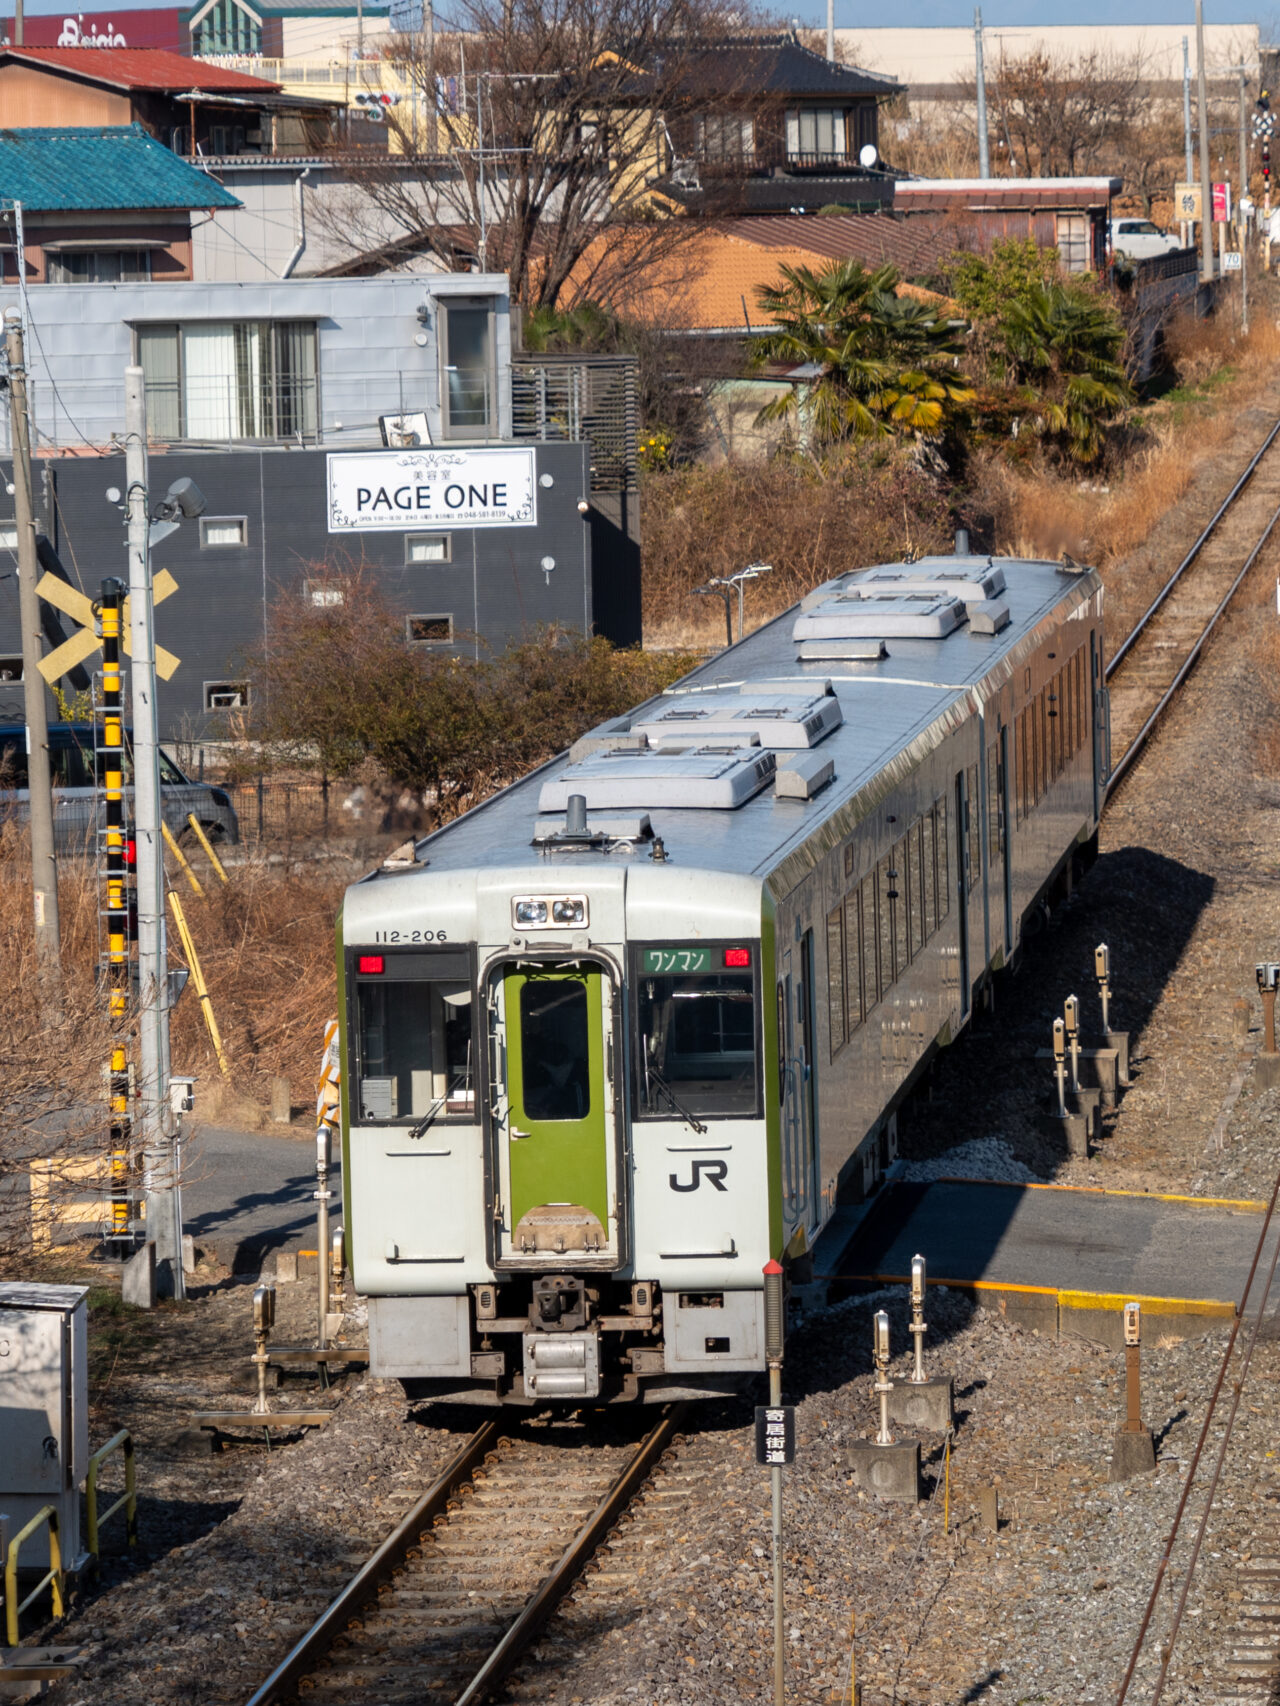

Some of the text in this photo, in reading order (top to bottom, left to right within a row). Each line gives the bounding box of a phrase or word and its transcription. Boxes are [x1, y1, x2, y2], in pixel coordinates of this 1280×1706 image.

[1226, 253, 1239, 264] 70
[412, 469, 451, 481] 美容室
[356, 483, 507, 511] PAGE ONE
[375, 930, 448, 943] 112-206
[650, 951, 704, 972] ワンマン
[669, 1159, 729, 1193] JR
[765, 1409, 786, 1463] 寄居街道
